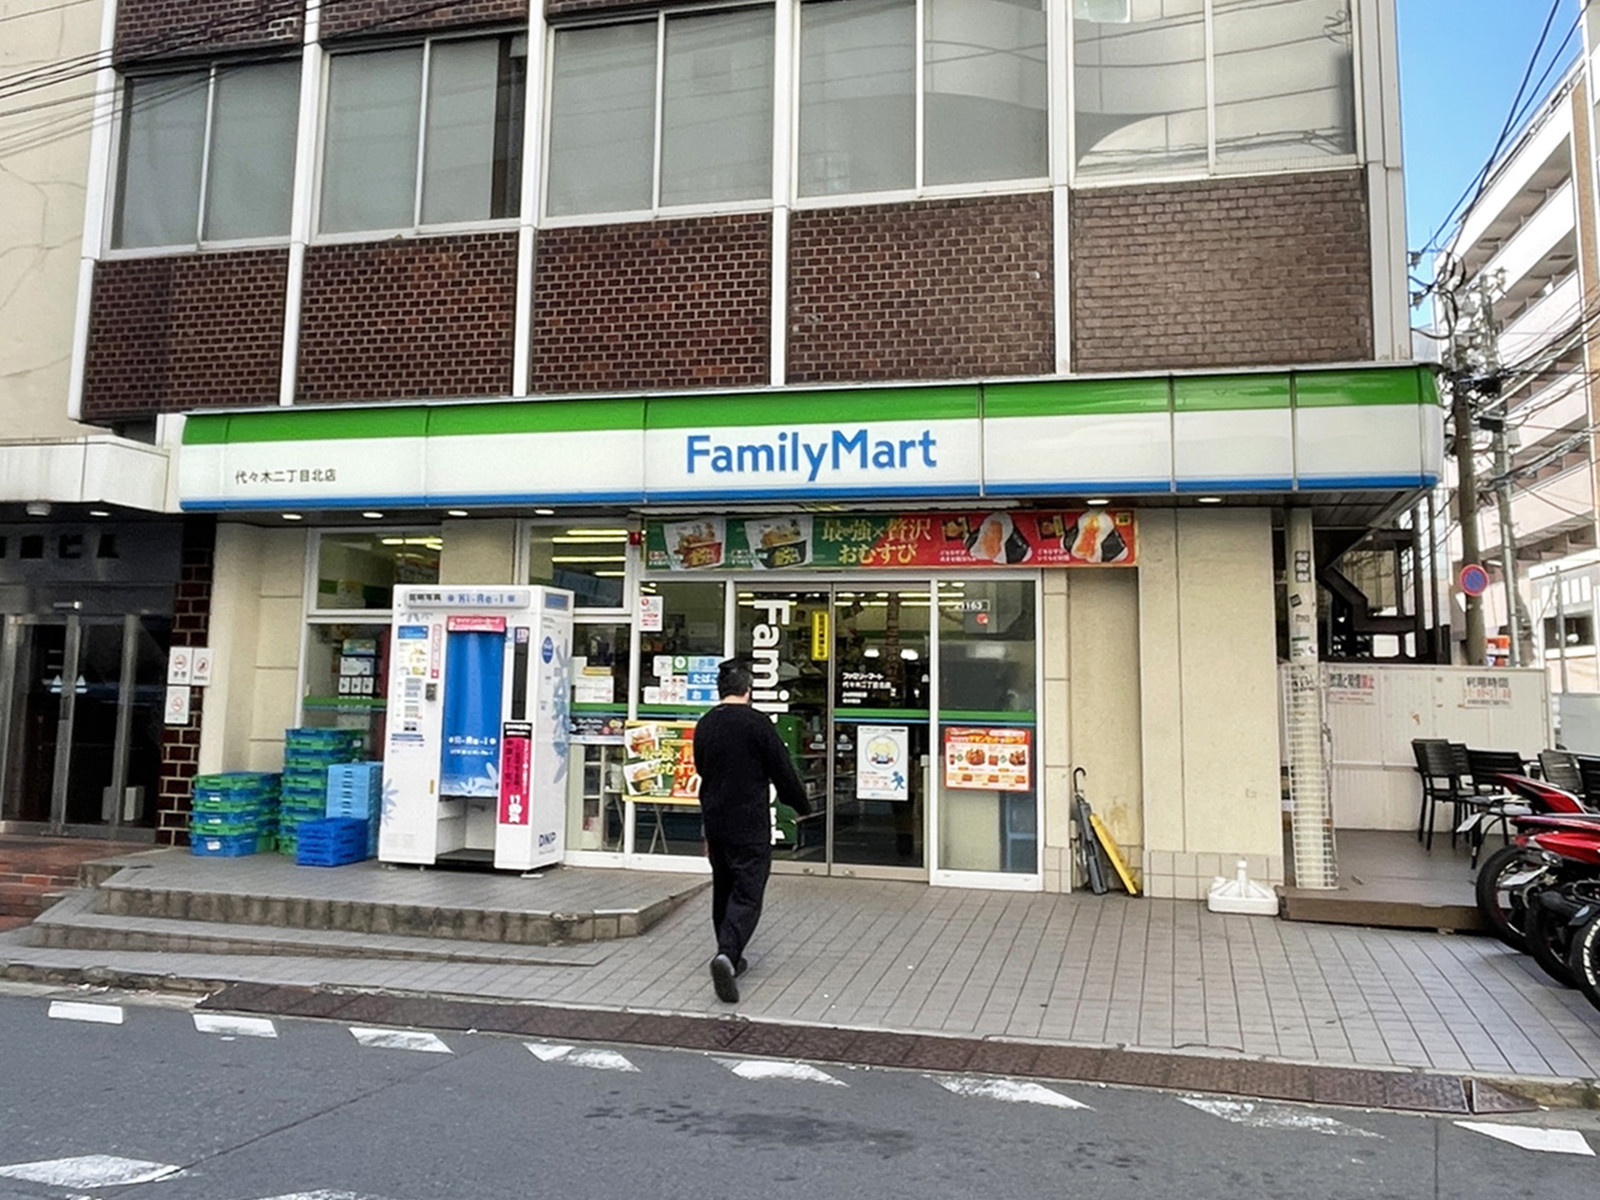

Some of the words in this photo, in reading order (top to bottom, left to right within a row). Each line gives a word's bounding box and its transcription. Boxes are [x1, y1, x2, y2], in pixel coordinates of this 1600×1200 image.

[687, 429, 937, 482] FamilyMart
[235, 469, 337, 485] 代々木二丁目北店
[838, 543, 919, 564] おむすび
